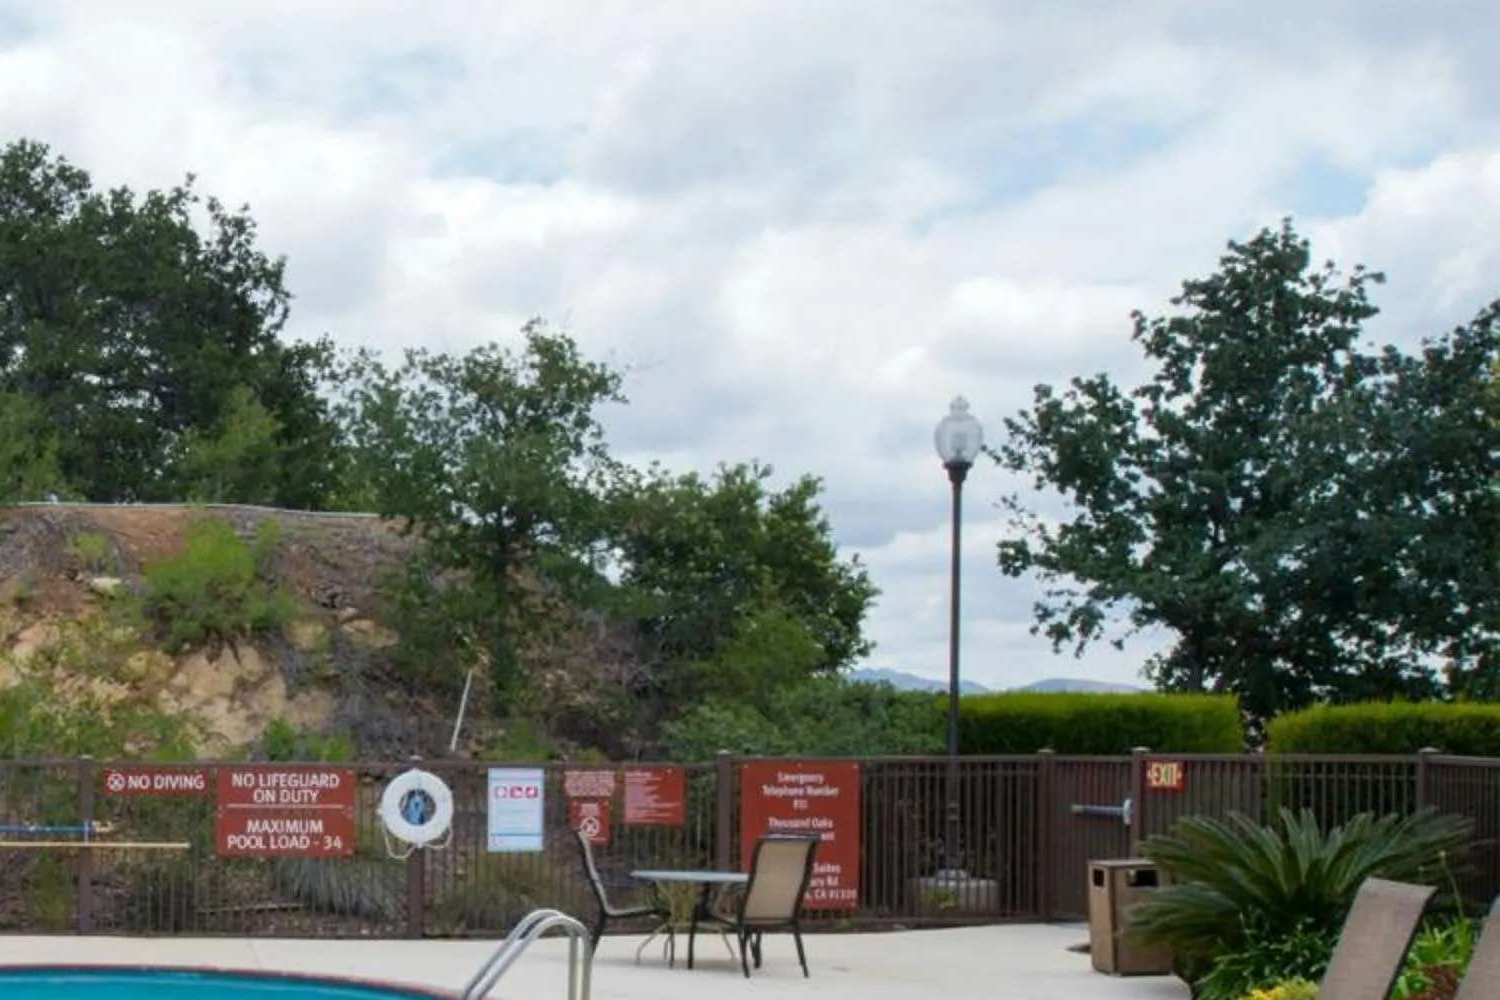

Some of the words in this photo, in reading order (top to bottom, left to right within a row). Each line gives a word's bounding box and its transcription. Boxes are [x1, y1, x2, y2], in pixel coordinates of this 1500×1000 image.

[127, 775, 150, 790] NO
[153, 774, 205, 790] DIVING
[232, 773, 255, 788] NO
[259, 773, 341, 789] LIFEGUARD
[1151, 762, 1178, 787] EXIT
[253, 789, 276, 803] ON
[279, 789, 320, 803] DUTY
[247, 819, 324, 834] MAXIMUM
[768, 817, 811, 829] Thousand
[811, 817, 834, 829] Oaks
[227, 835, 267, 850] POOL
[269, 835, 311, 850] LOAD
[323, 835, 343, 851] 34
